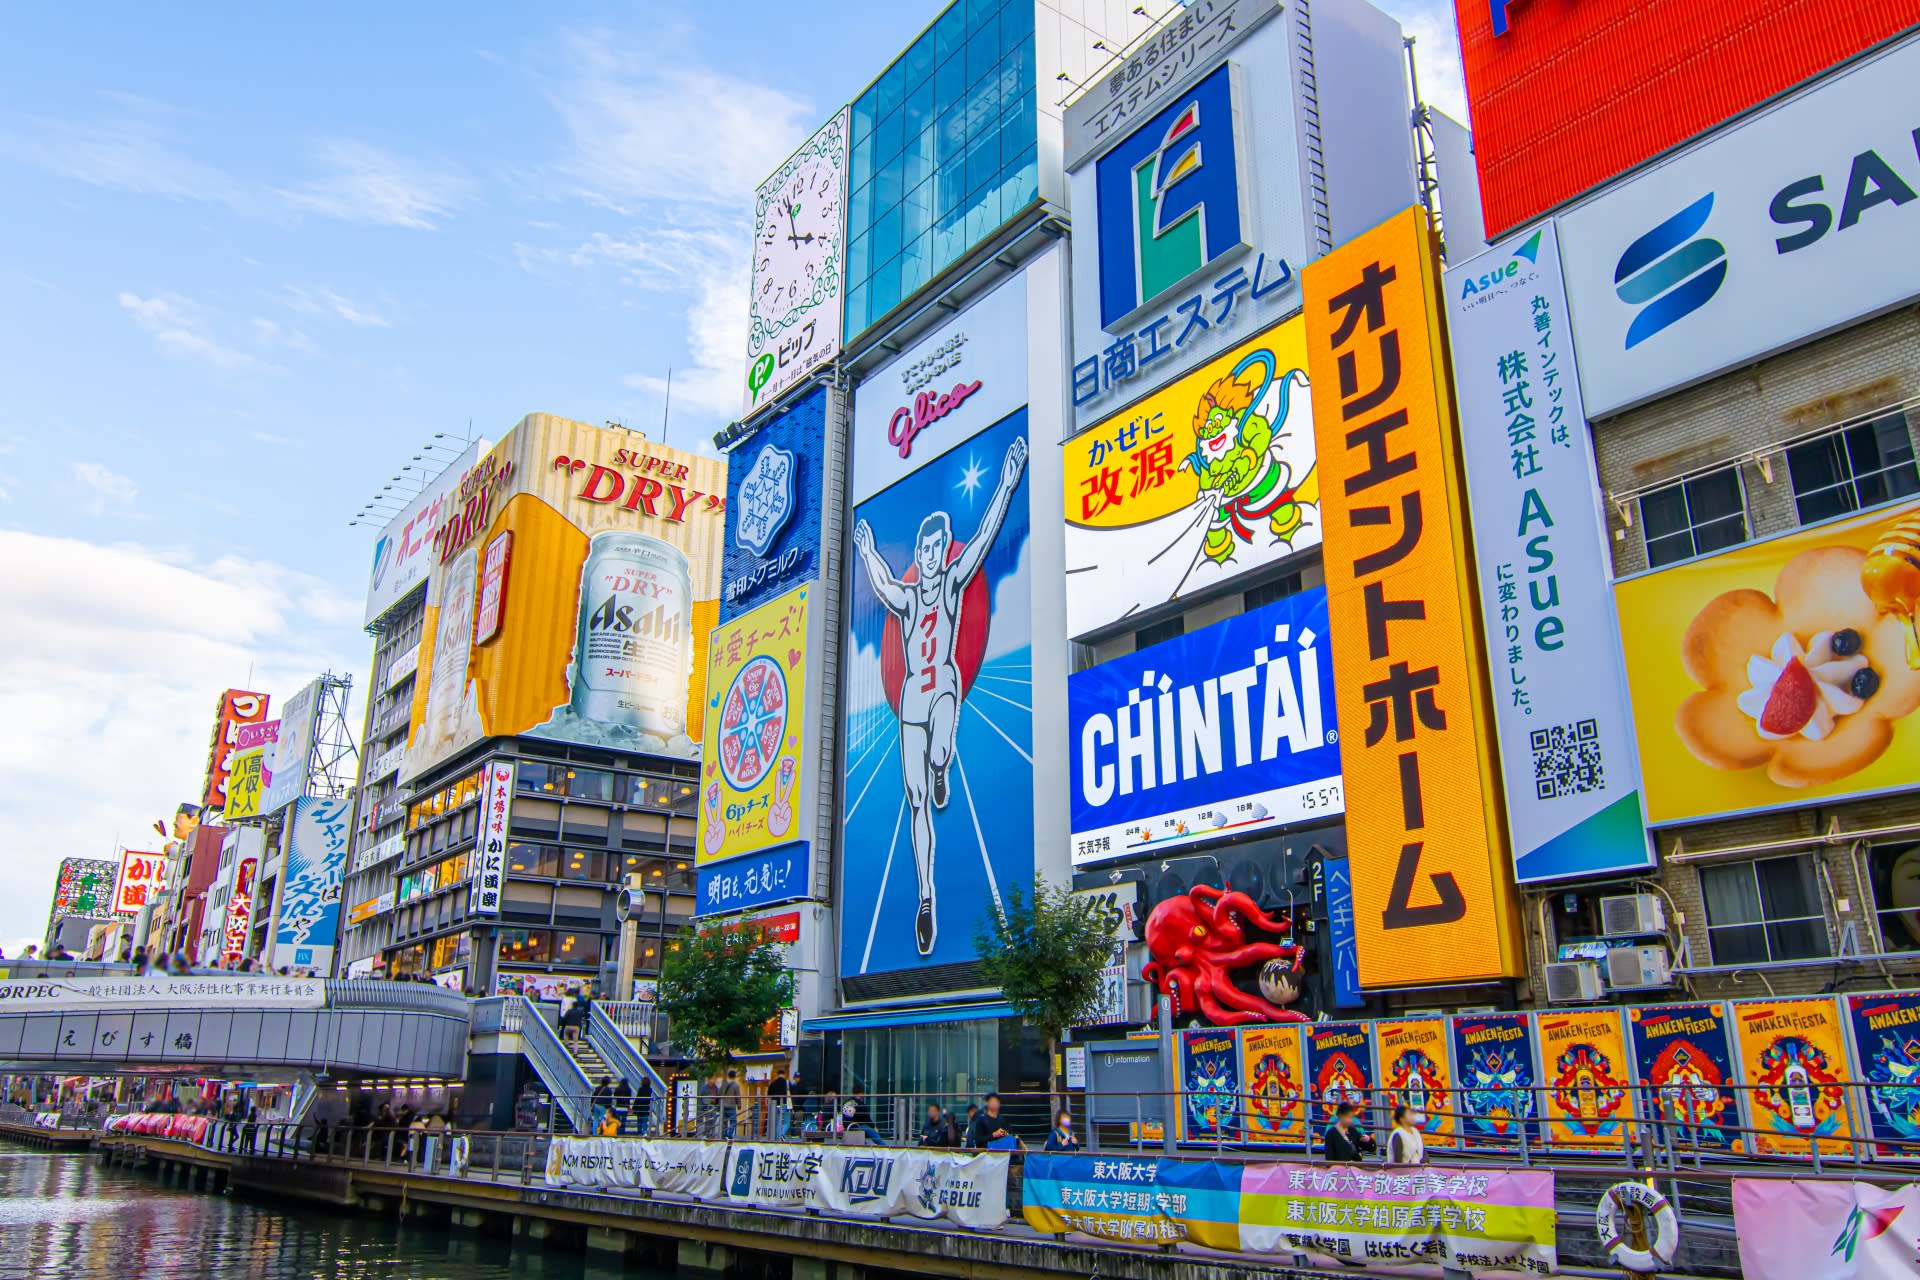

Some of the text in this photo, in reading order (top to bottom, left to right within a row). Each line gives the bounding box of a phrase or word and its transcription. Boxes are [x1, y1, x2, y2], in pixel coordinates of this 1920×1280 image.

[1108, 2, 1214, 95] 夢ある住まい
[1094, 9, 1237, 140] エステムシリーズ
[1768, 126, 1920, 256] SA
[1461, 259, 1520, 301] Asue
[778, 318, 817, 369] ピップ
[1072, 252, 1295, 409] 日商エステム
[1530, 295, 1572, 450] 丸善インテックは、
[887, 379, 984, 460] Glico
[1088, 411, 1166, 468] かぜに
[459, 455, 495, 504] SUPER
[613, 448, 690, 481] SUPER
[1081, 434, 1175, 521] 改源
[624, 567, 658, 582] SUPER
[725, 546, 799, 602] 雪印メグミルク
[1328, 260, 1468, 931] オリエントホーム
[588, 593, 682, 647] Asahi
[621, 639, 646, 658] 生
[919, 604, 940, 694] グリコ
[1496, 563, 1532, 717] に変わりました。
[1081, 622, 1325, 808] CHINTAI
[310, 800, 350, 902] シャッターは
[481, 785, 508, 908] 本場の味 かに道楽
[1078, 836, 1111, 857] 天気予報
[1312, 861, 1324, 902] 2F
[73, 982, 316, 998] 一般社団法人 大阪活性化事業実行委員会
[1465, 1028, 1498, 1046] AWAKEN
[1498, 1027, 1524, 1043] FIESTA
[1548, 1024, 1584, 1042] AWAKEN
[1584, 1023, 1612, 1039] FIESTA
[1645, 1019, 1685, 1039] AWAKEN
[1684, 1017, 1718, 1036] FIESTA
[1748, 1014, 1792, 1035] AWAKEN
[1792, 1013, 1828, 1031] FIESTA
[1868, 1007, 1917, 1031] AWAKEN
[1191, 1039, 1233, 1055] AWAKEN FIESTA
[1249, 1037, 1293, 1052] AWAKEN FIESTA
[1316, 1034, 1344, 1051] AWAKEN
[1343, 1034, 1365, 1048] FIESTA
[1385, 1032, 1415, 1048] AWAKEN
[1415, 1031, 1438, 1045] FIESTA
[1115, 1055, 1151, 1064] information
[758, 1151, 824, 1184] 近畿大学
[1092, 1160, 1158, 1183] 東大阪大学
[1288, 1169, 1489, 1198] 東大阪大学敬愛高等学校
[1060, 1186, 1188, 1215] 東大阪大学短期学部
[1286, 1200, 1486, 1232] 東大阪大学柏原高等学校
